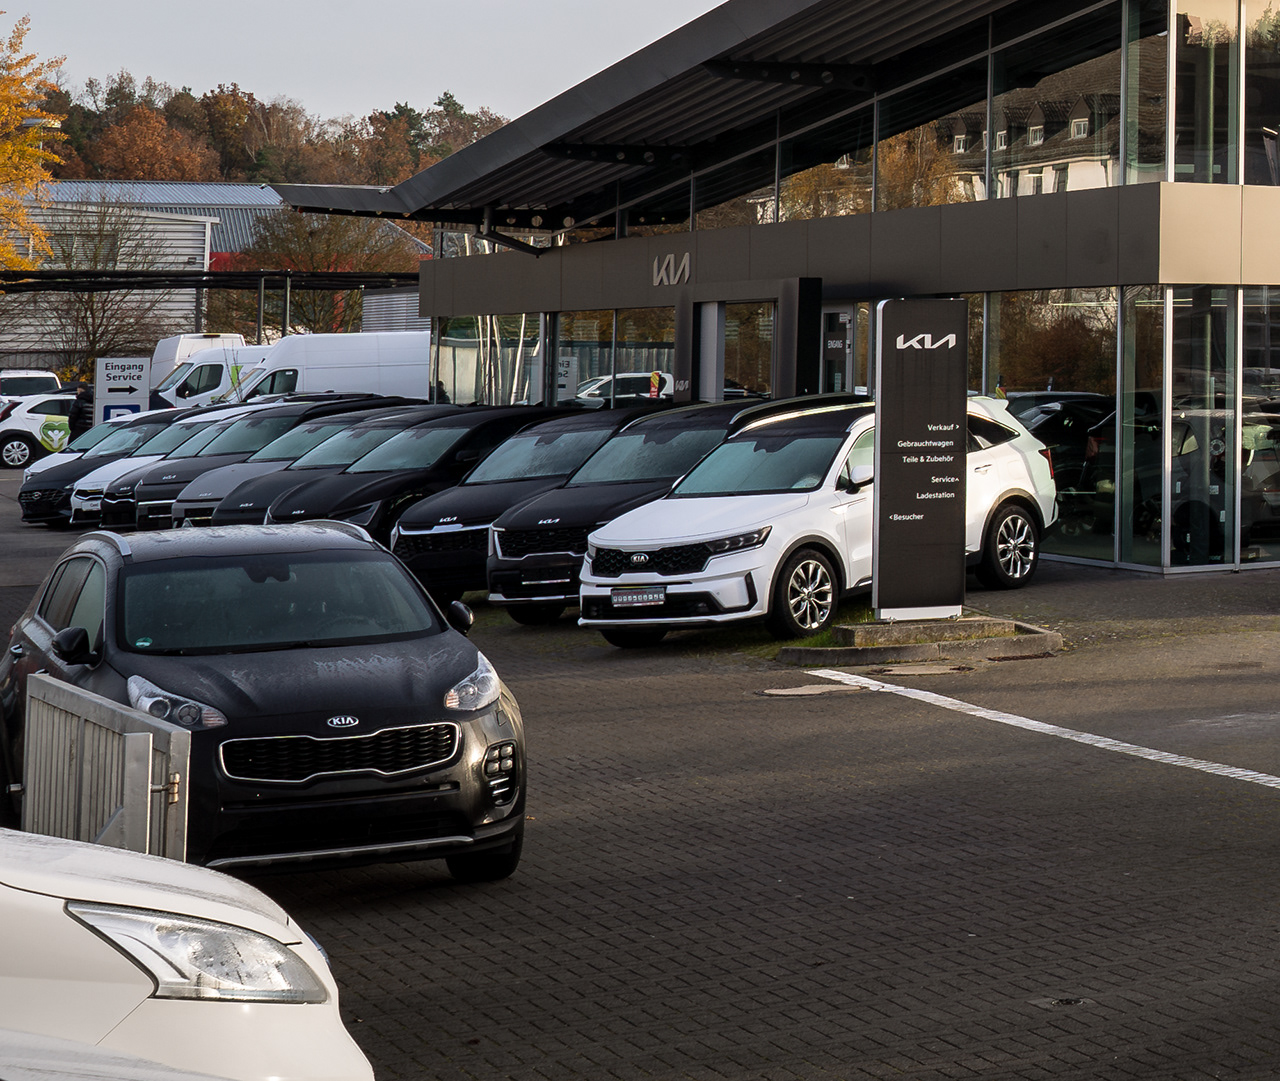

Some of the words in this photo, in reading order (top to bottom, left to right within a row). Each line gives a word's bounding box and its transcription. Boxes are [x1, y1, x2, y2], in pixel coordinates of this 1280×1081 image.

[105, 362, 143, 372] Eingang
[105, 373, 142, 381] Service
[927, 423, 955, 431] Verkauf
[897, 440, 954, 448] Gebrauchtwagen
[902, 455, 919, 463] Teile
[926, 454, 955, 462] Zubehör
[931, 475, 956, 483] Service
[916, 491, 955, 499] Ladestation
[893, 513, 925, 521] Besucher
[332, 717, 354, 725] KIA
